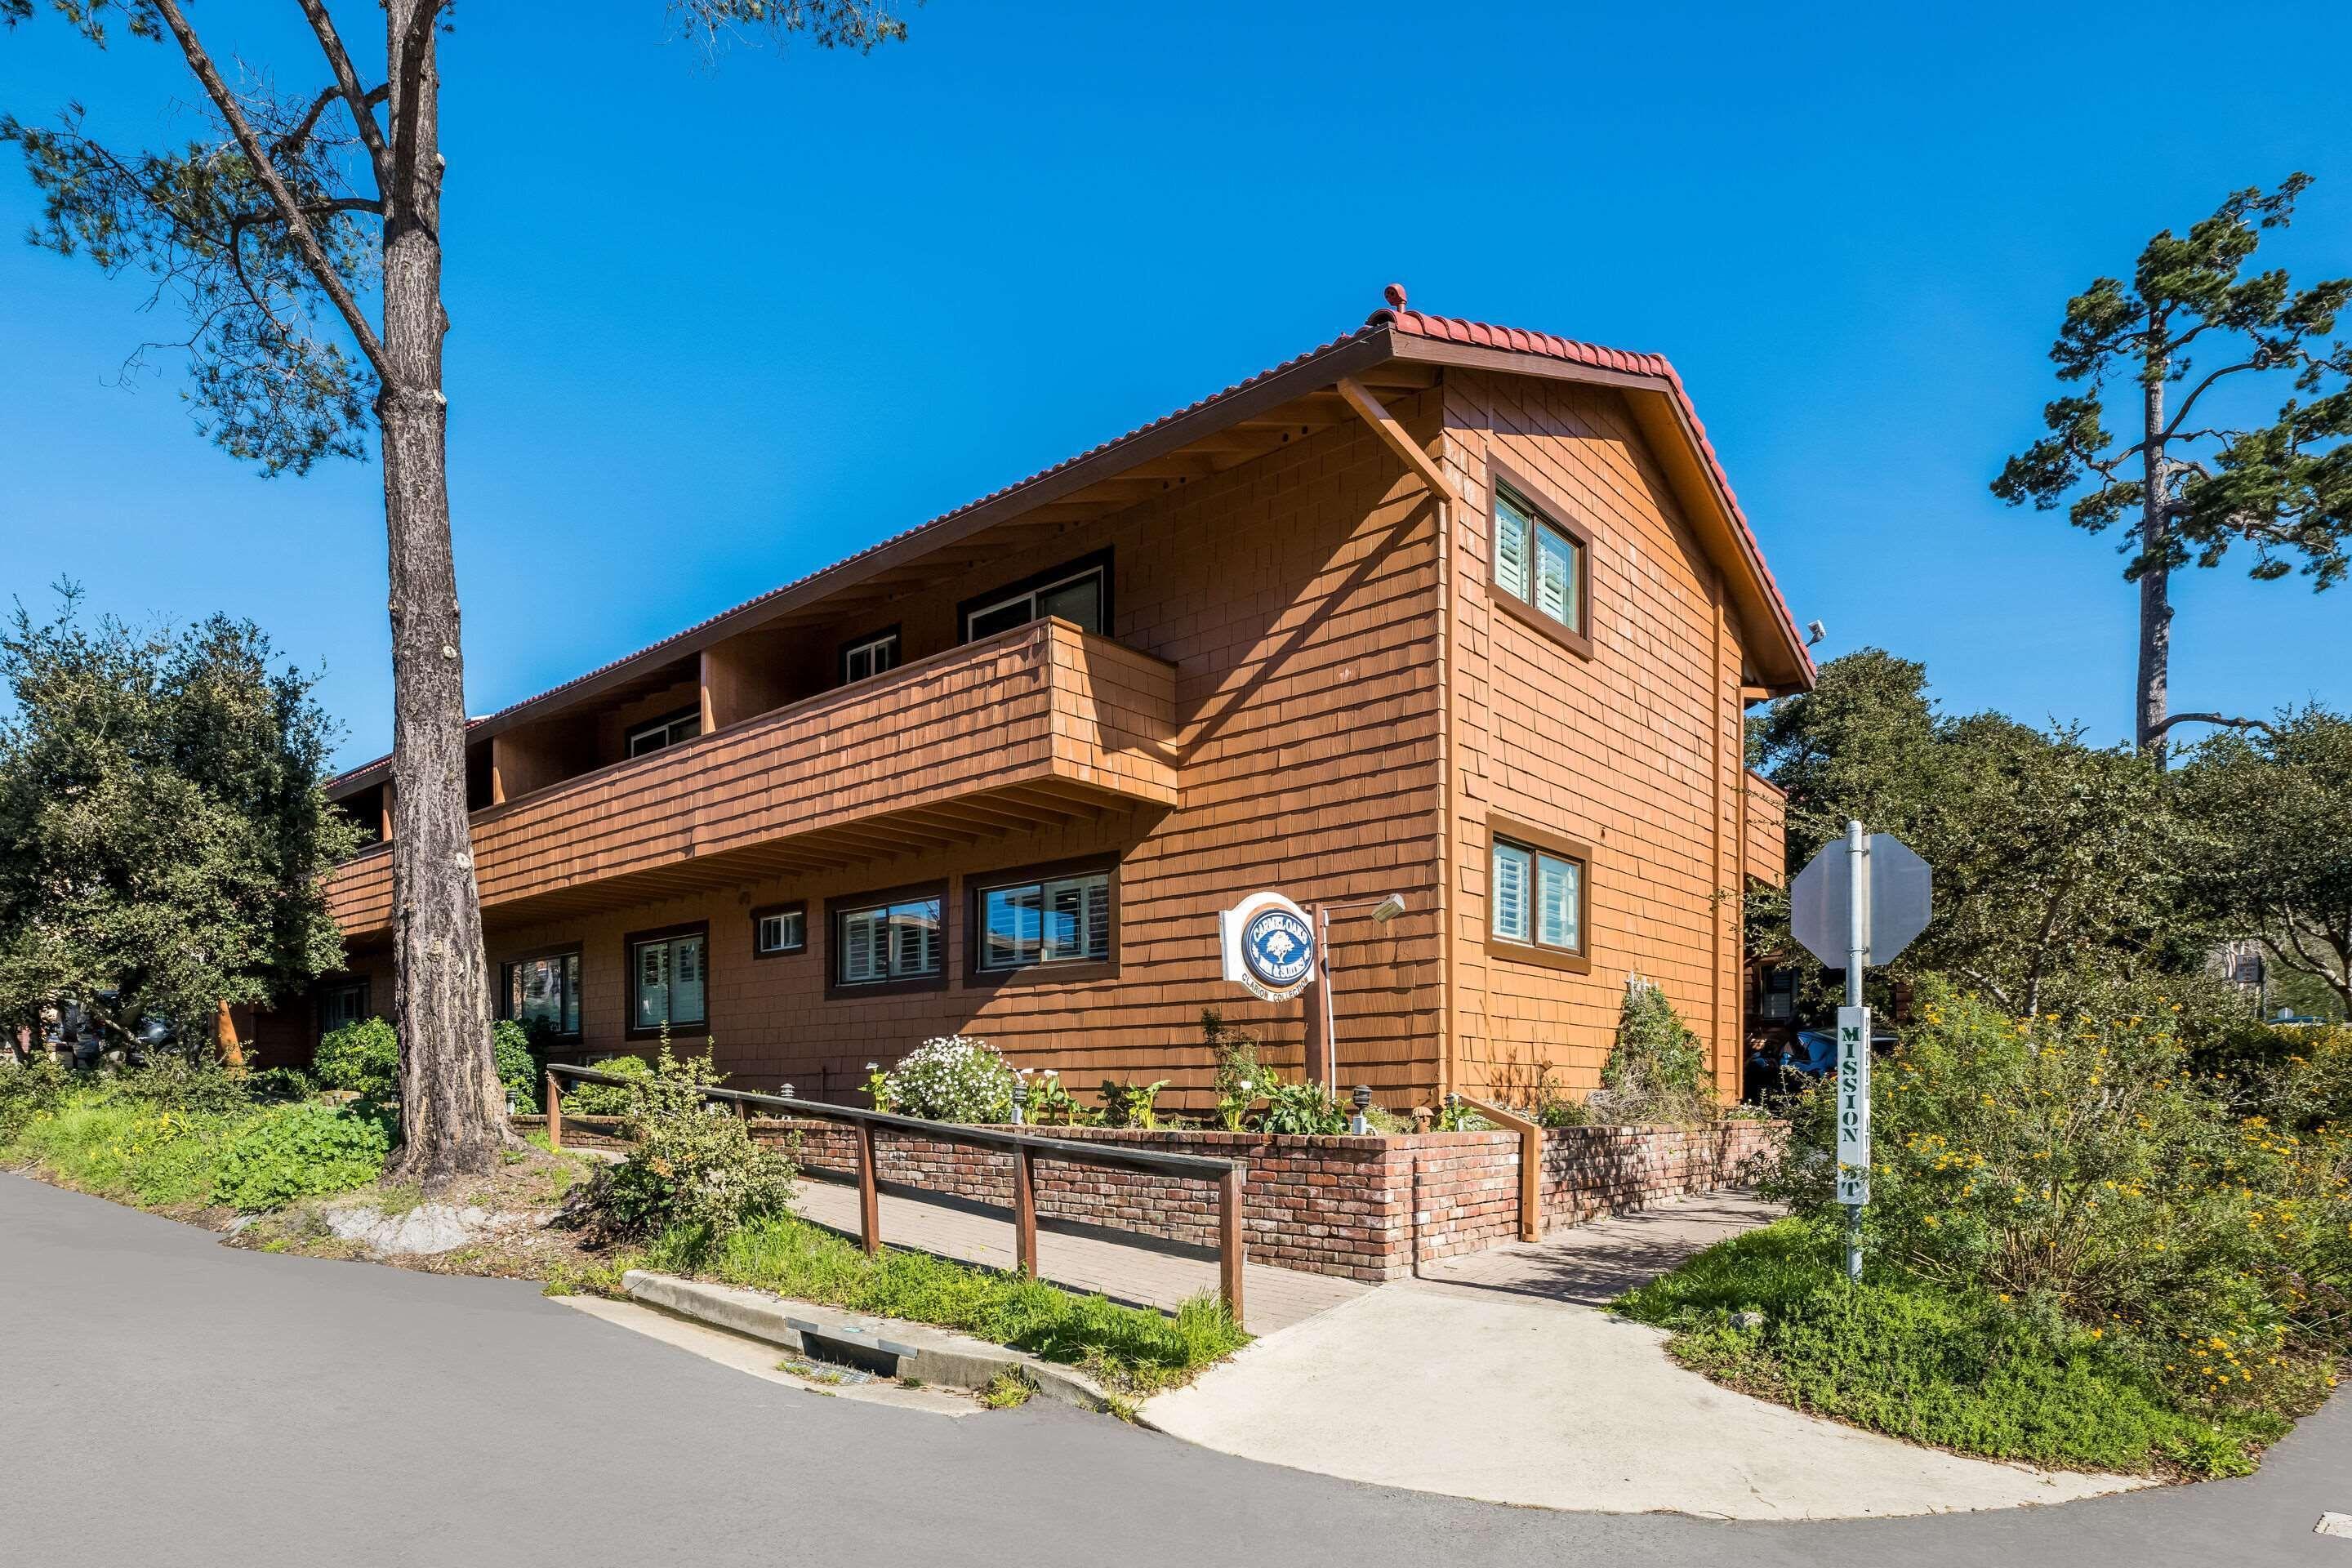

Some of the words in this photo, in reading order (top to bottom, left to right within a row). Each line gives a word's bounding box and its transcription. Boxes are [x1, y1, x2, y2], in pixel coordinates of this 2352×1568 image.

[1254, 916, 1285, 942] CARMEL
[1285, 919, 1307, 945] OAKS
[1241, 973, 1269, 1000] CLARION
[1273, 976, 1308, 1002] COLLECTION
[1841, 1027, 1860, 1143] MISSION
